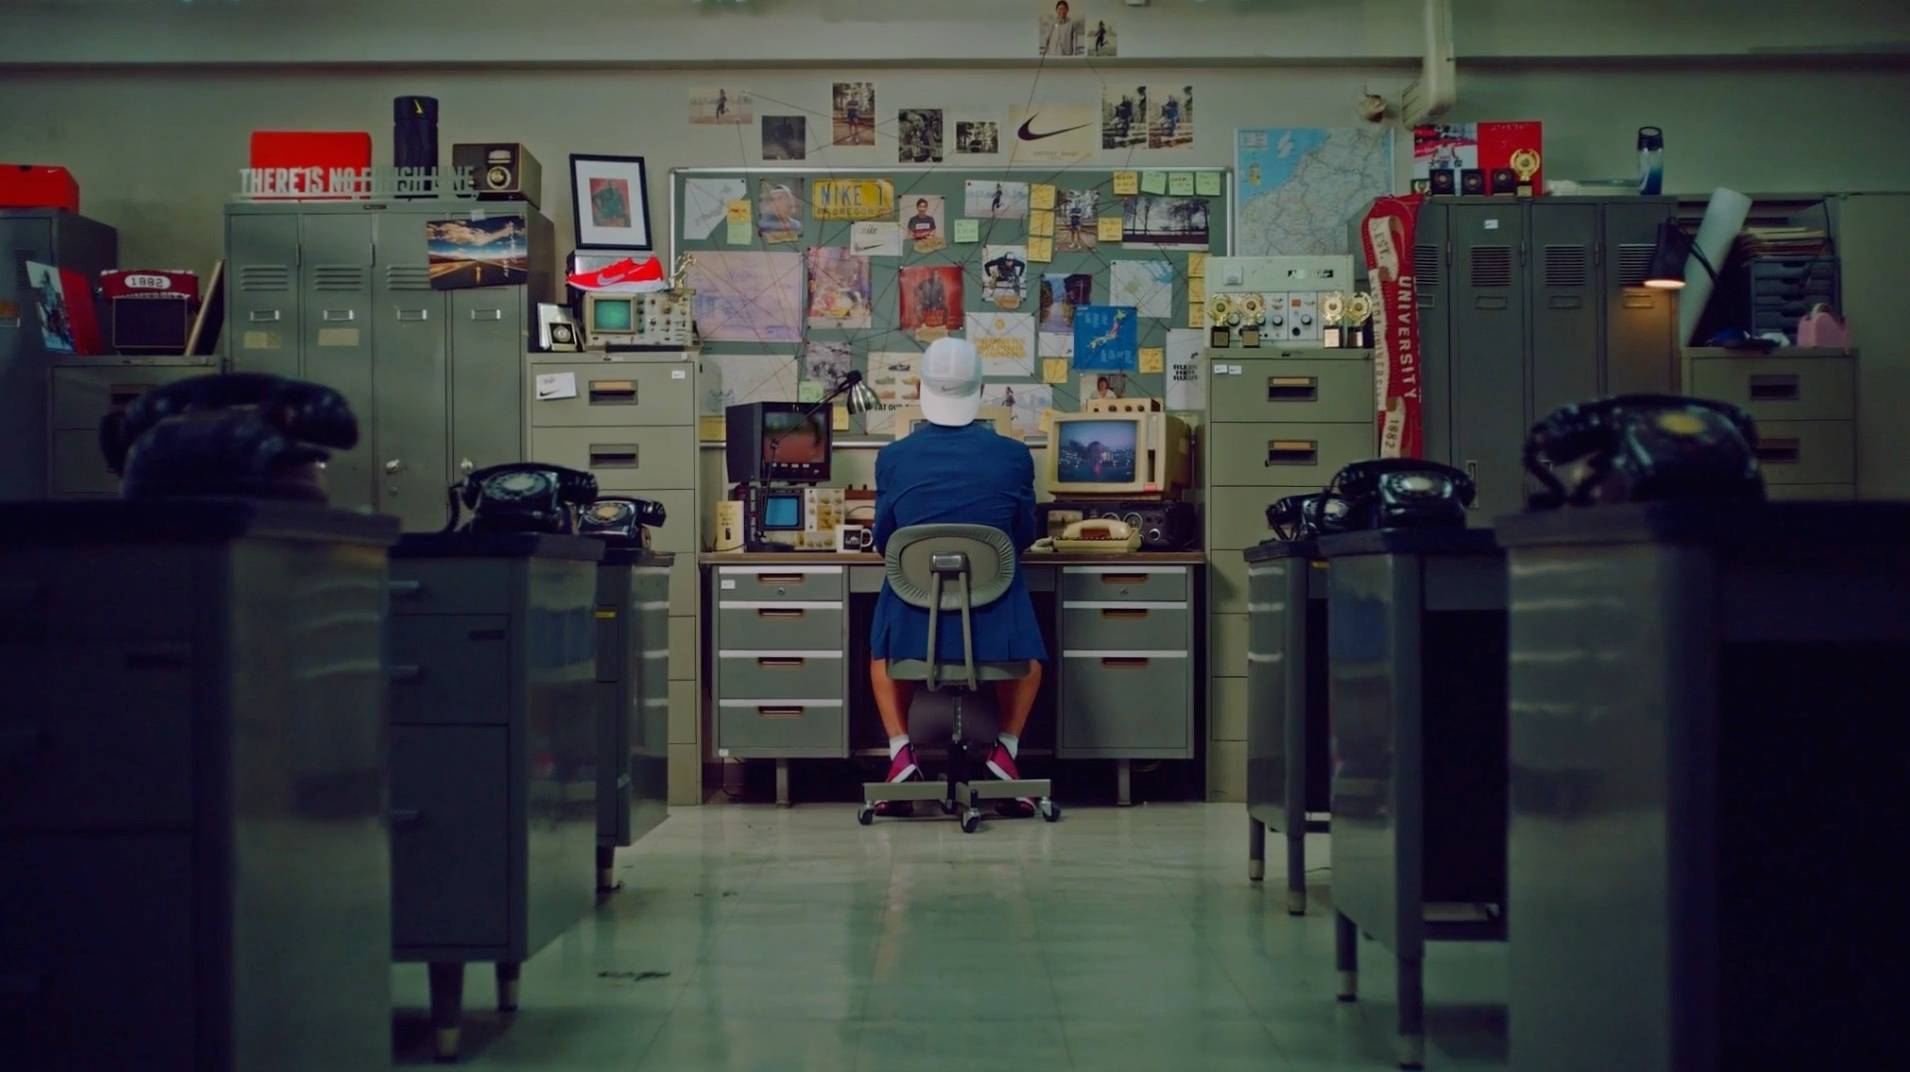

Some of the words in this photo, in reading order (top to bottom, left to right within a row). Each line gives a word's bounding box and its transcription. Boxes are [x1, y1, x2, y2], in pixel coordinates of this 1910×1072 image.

[239, 167, 300, 193] THERE
[304, 167, 324, 193] IS
[329, 167, 355, 193] NO
[821, 182, 862, 206] NIKE
[1374, 232, 1391, 259] EST.
[1397, 275, 1417, 399] UNIVERSITY
[1385, 419, 1399, 449] 1882
